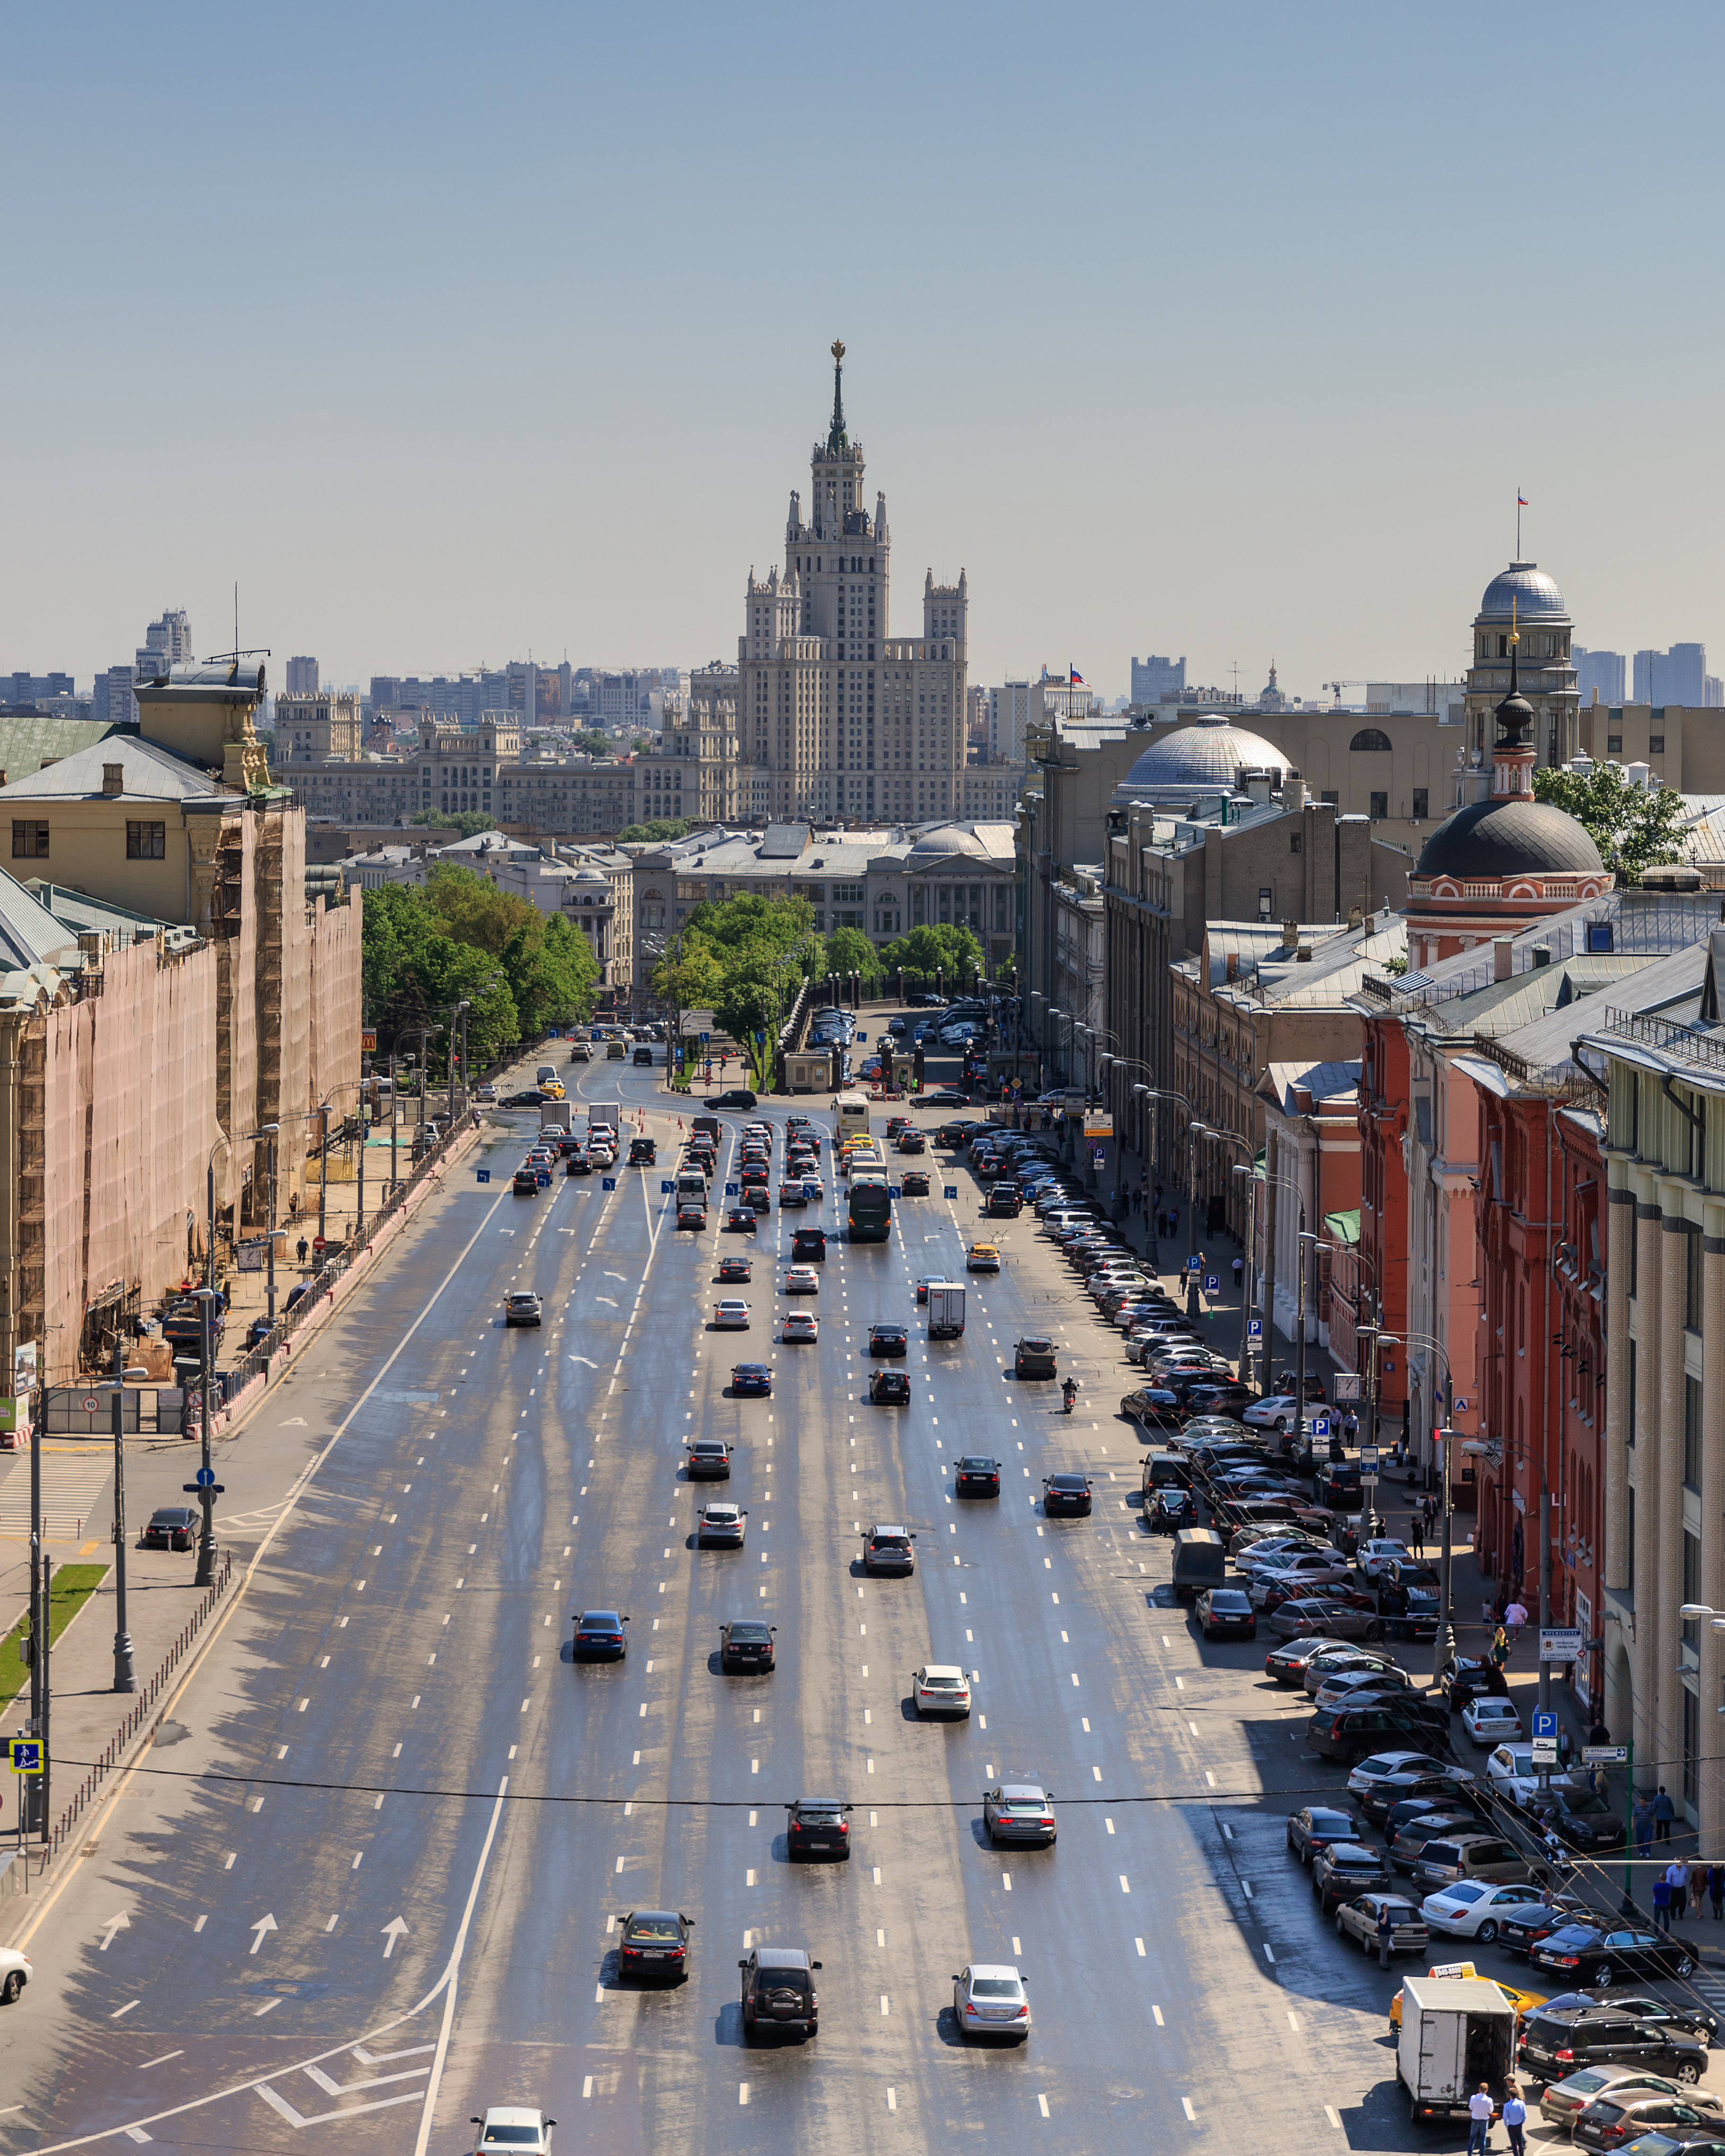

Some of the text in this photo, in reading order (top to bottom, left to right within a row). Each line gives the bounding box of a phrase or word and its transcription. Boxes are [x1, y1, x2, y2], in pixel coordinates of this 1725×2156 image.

[1097, 1149, 1103, 1157] P
[1192, 1258, 1198, 1268] P
[1209, 1277, 1217, 1288] P
[1251, 1321, 1259, 1334] P
[1316, 1420, 1325, 1434] P
[1539, 1715, 1551, 1733] P
